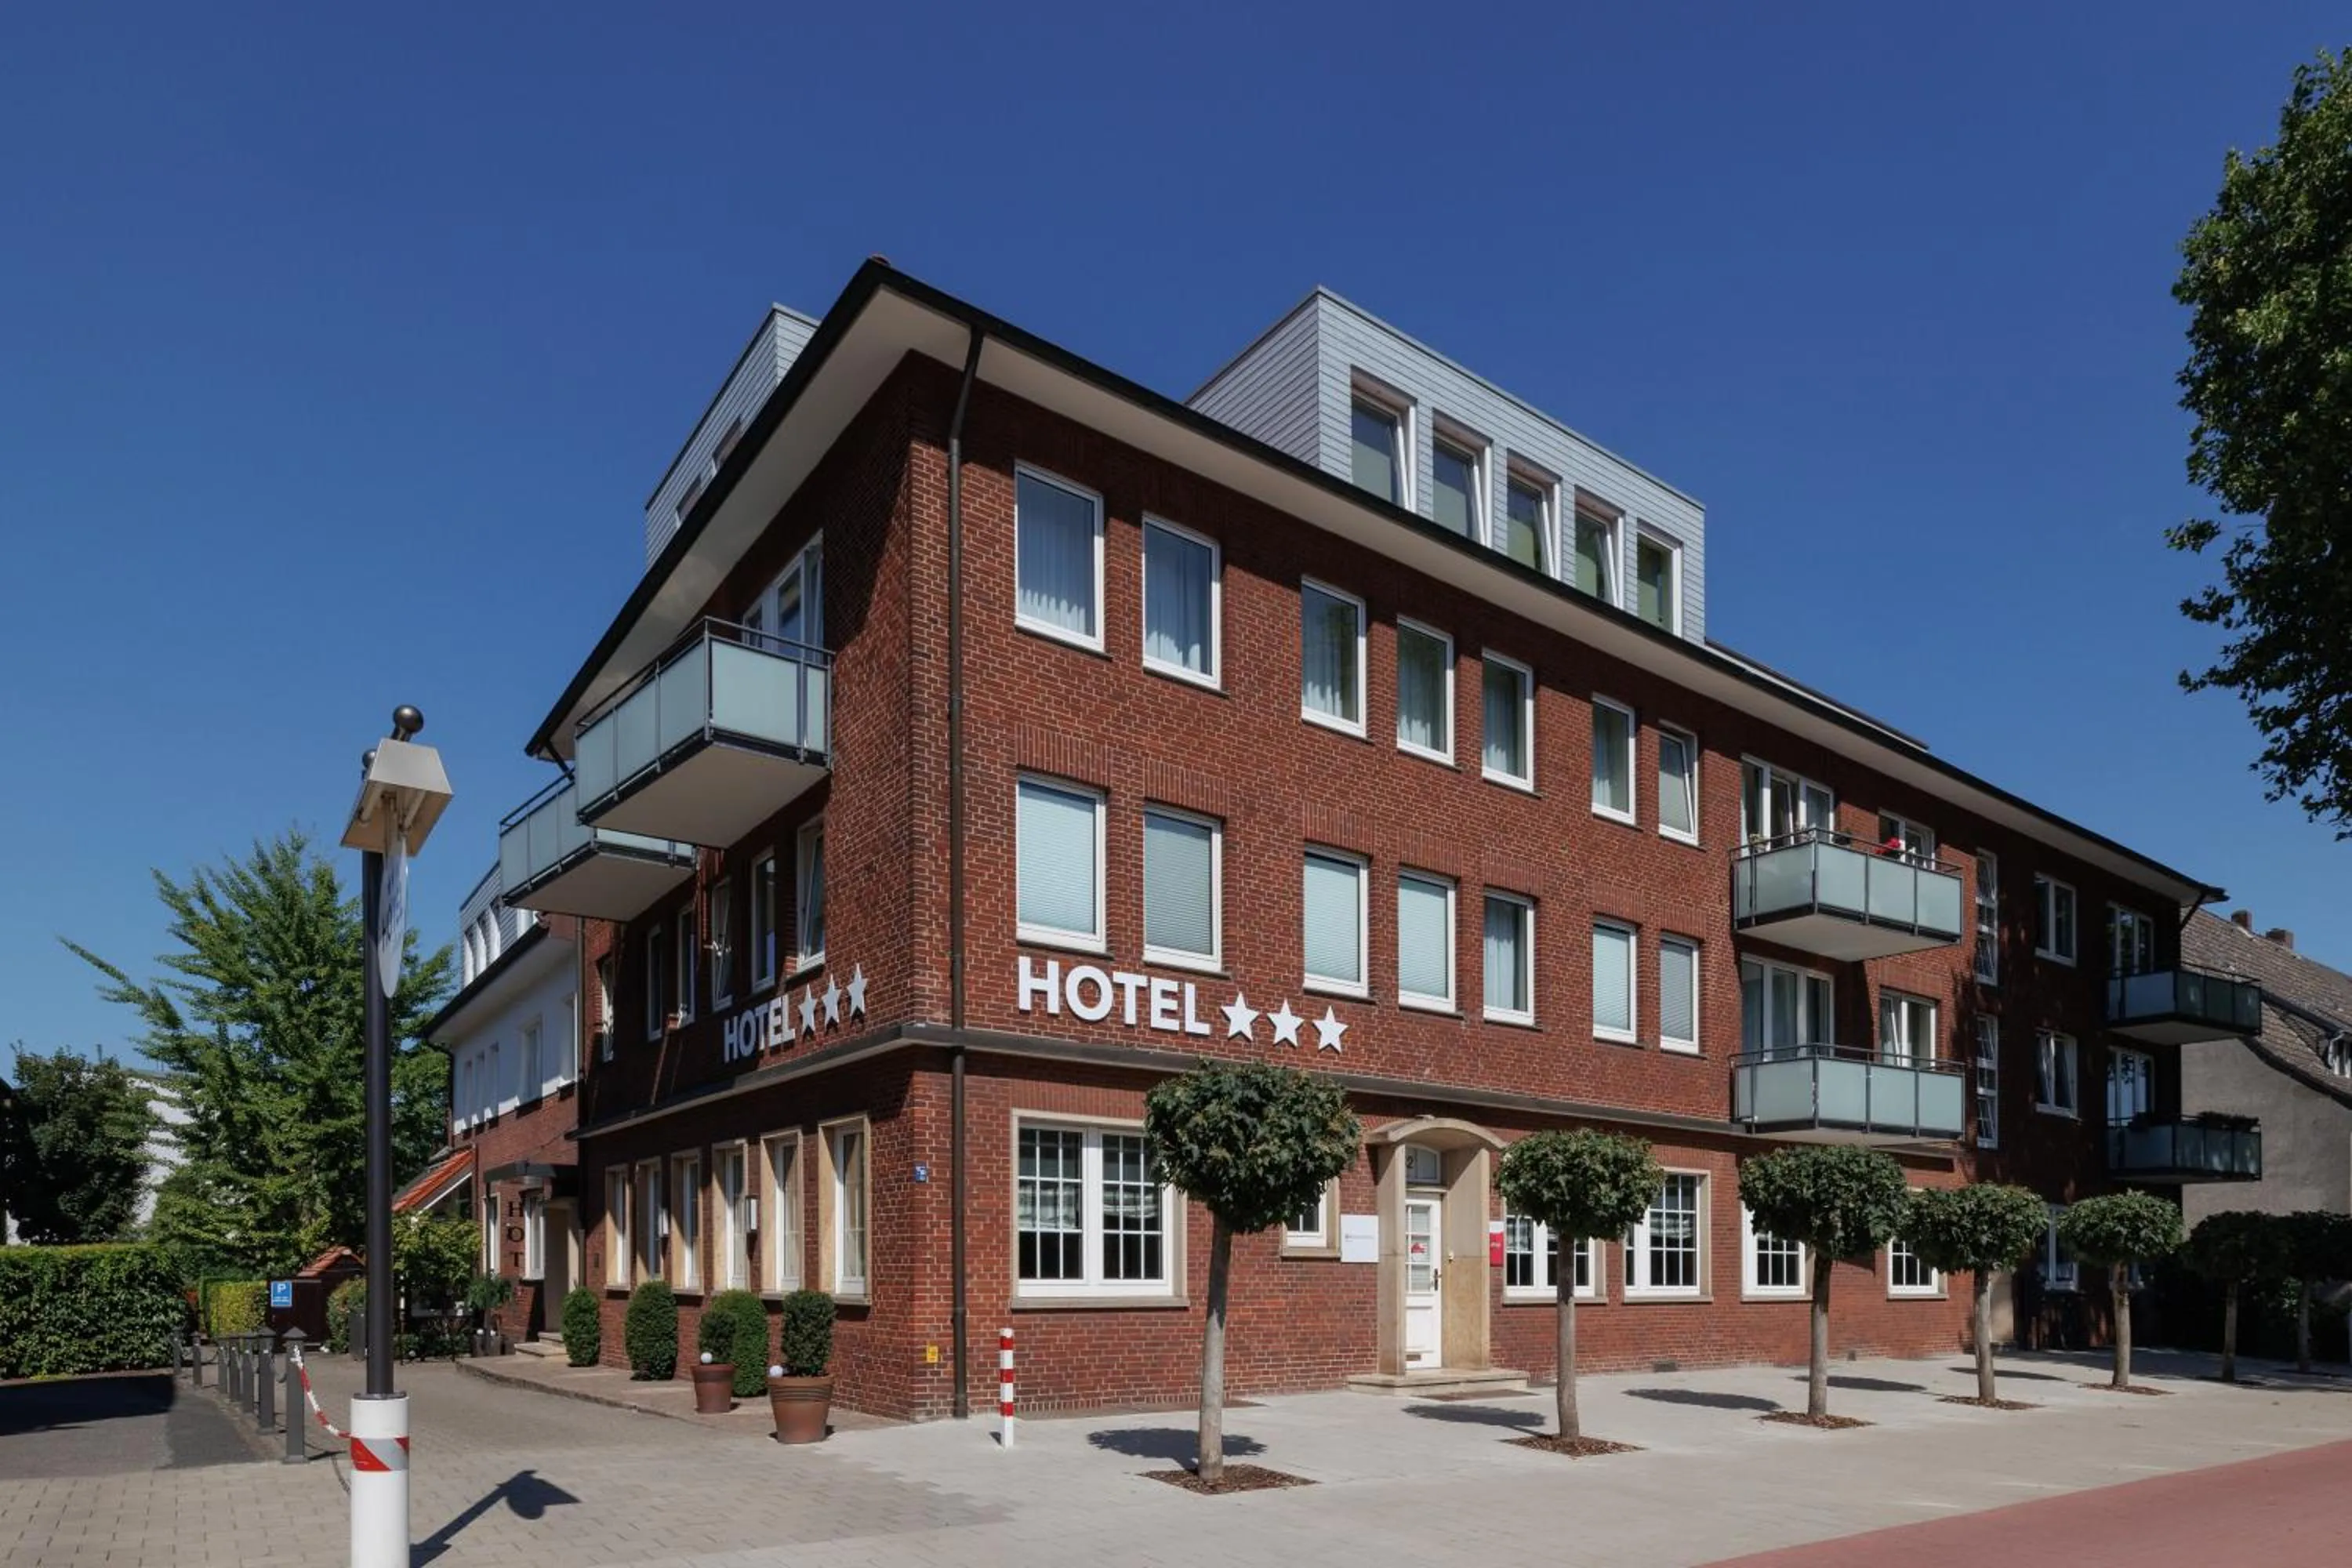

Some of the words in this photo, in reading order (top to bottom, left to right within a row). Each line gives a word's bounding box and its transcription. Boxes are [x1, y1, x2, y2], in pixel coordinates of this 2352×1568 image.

[724, 994, 796, 1063] HOTEL
[1018, 956, 1210, 1036] HOTEL
[277, 1283, 286, 1293] P
